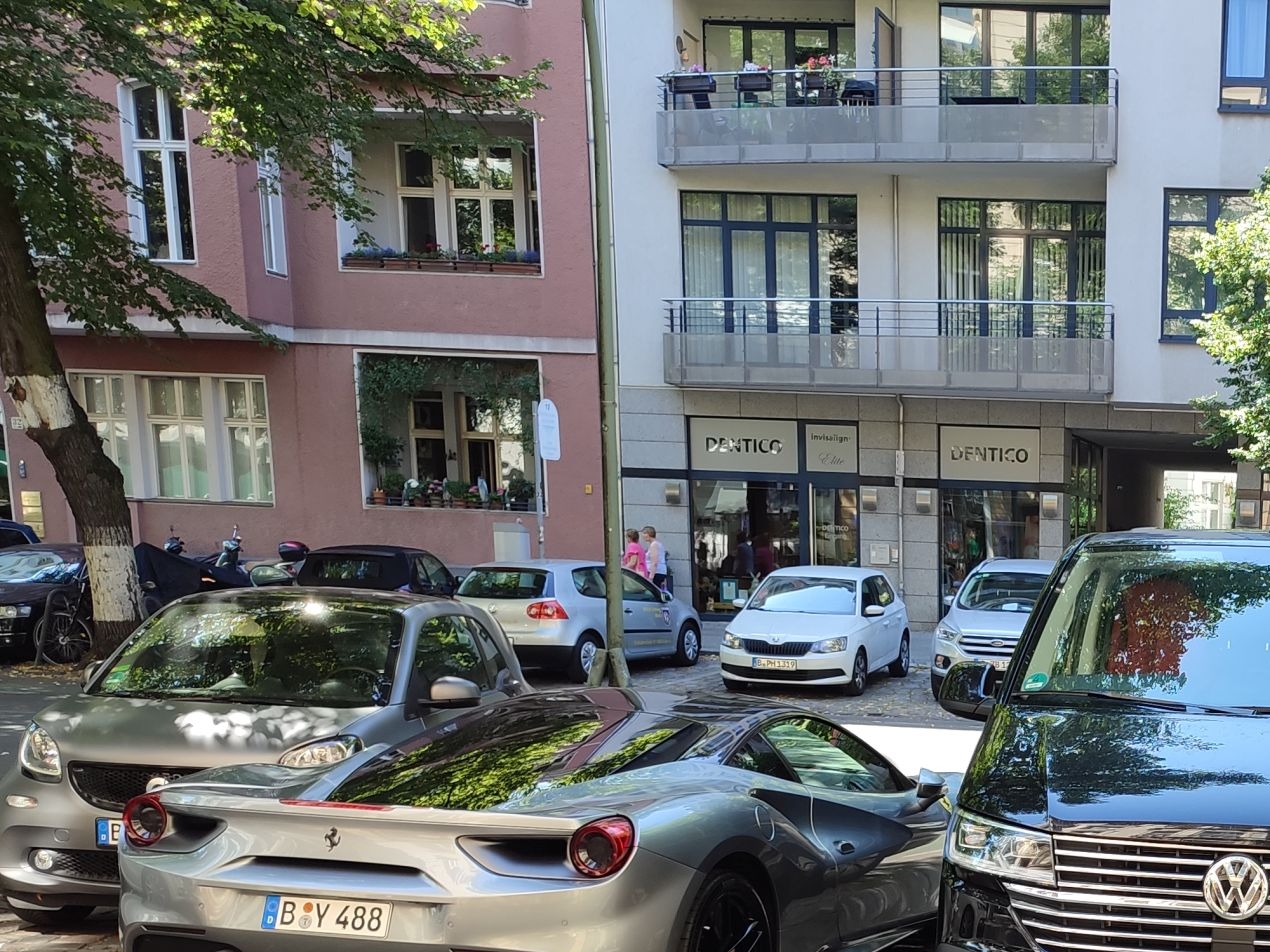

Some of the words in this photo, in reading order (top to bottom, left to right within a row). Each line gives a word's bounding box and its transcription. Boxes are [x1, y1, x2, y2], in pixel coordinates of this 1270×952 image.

[705, 437, 783, 455] DENTICO
[951, 446, 1029, 463] DENTICO
[267, 915, 274, 924] D
[280, 901, 296, 925] B
[316, 903, 330, 928] Y
[335, 904, 382, 931] 488
